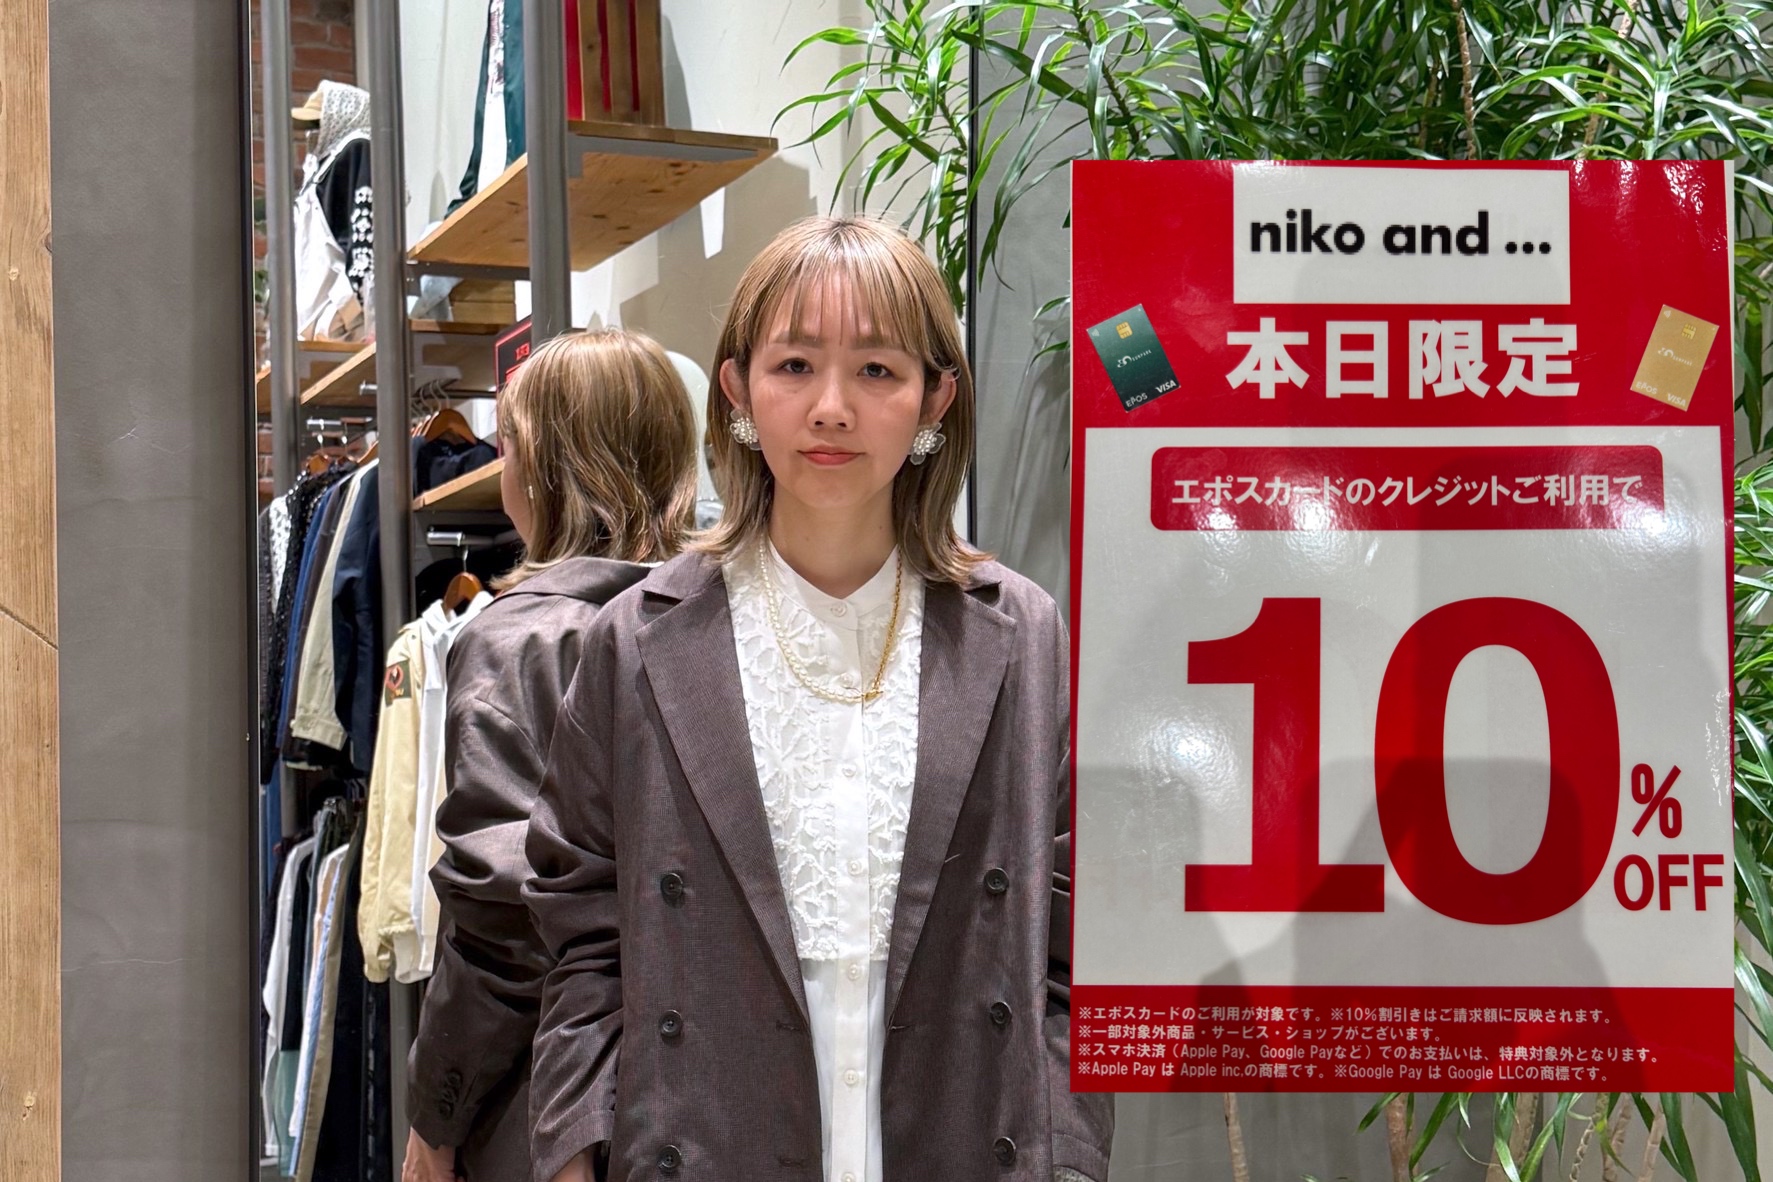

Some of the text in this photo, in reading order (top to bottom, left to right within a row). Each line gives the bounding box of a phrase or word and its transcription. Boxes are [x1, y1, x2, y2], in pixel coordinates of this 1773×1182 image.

[1251, 209, 1365, 255] niko
[1382, 210, 1489, 256] and
[1226, 318, 1580, 400] 本日限定
[1155, 379, 1177, 393] VISA
[1635, 381, 1658, 395] EPOS
[1125, 392, 1148, 408] EPOS
[1667, 392, 1687, 407] VISA
[1171, 474, 1643, 507] エポスカードのクレジットご利用で
[1613, 853, 1724, 911] OFF
[1132, 1062, 1157, 1078] Pay
[1161, 1063, 1175, 1076] は
[1180, 1063, 1218, 1078] Apple
[1399, 1065, 1423, 1081] Pay
[1428, 1065, 1442, 1079] は
[1447, 1065, 1494, 1081] Google
